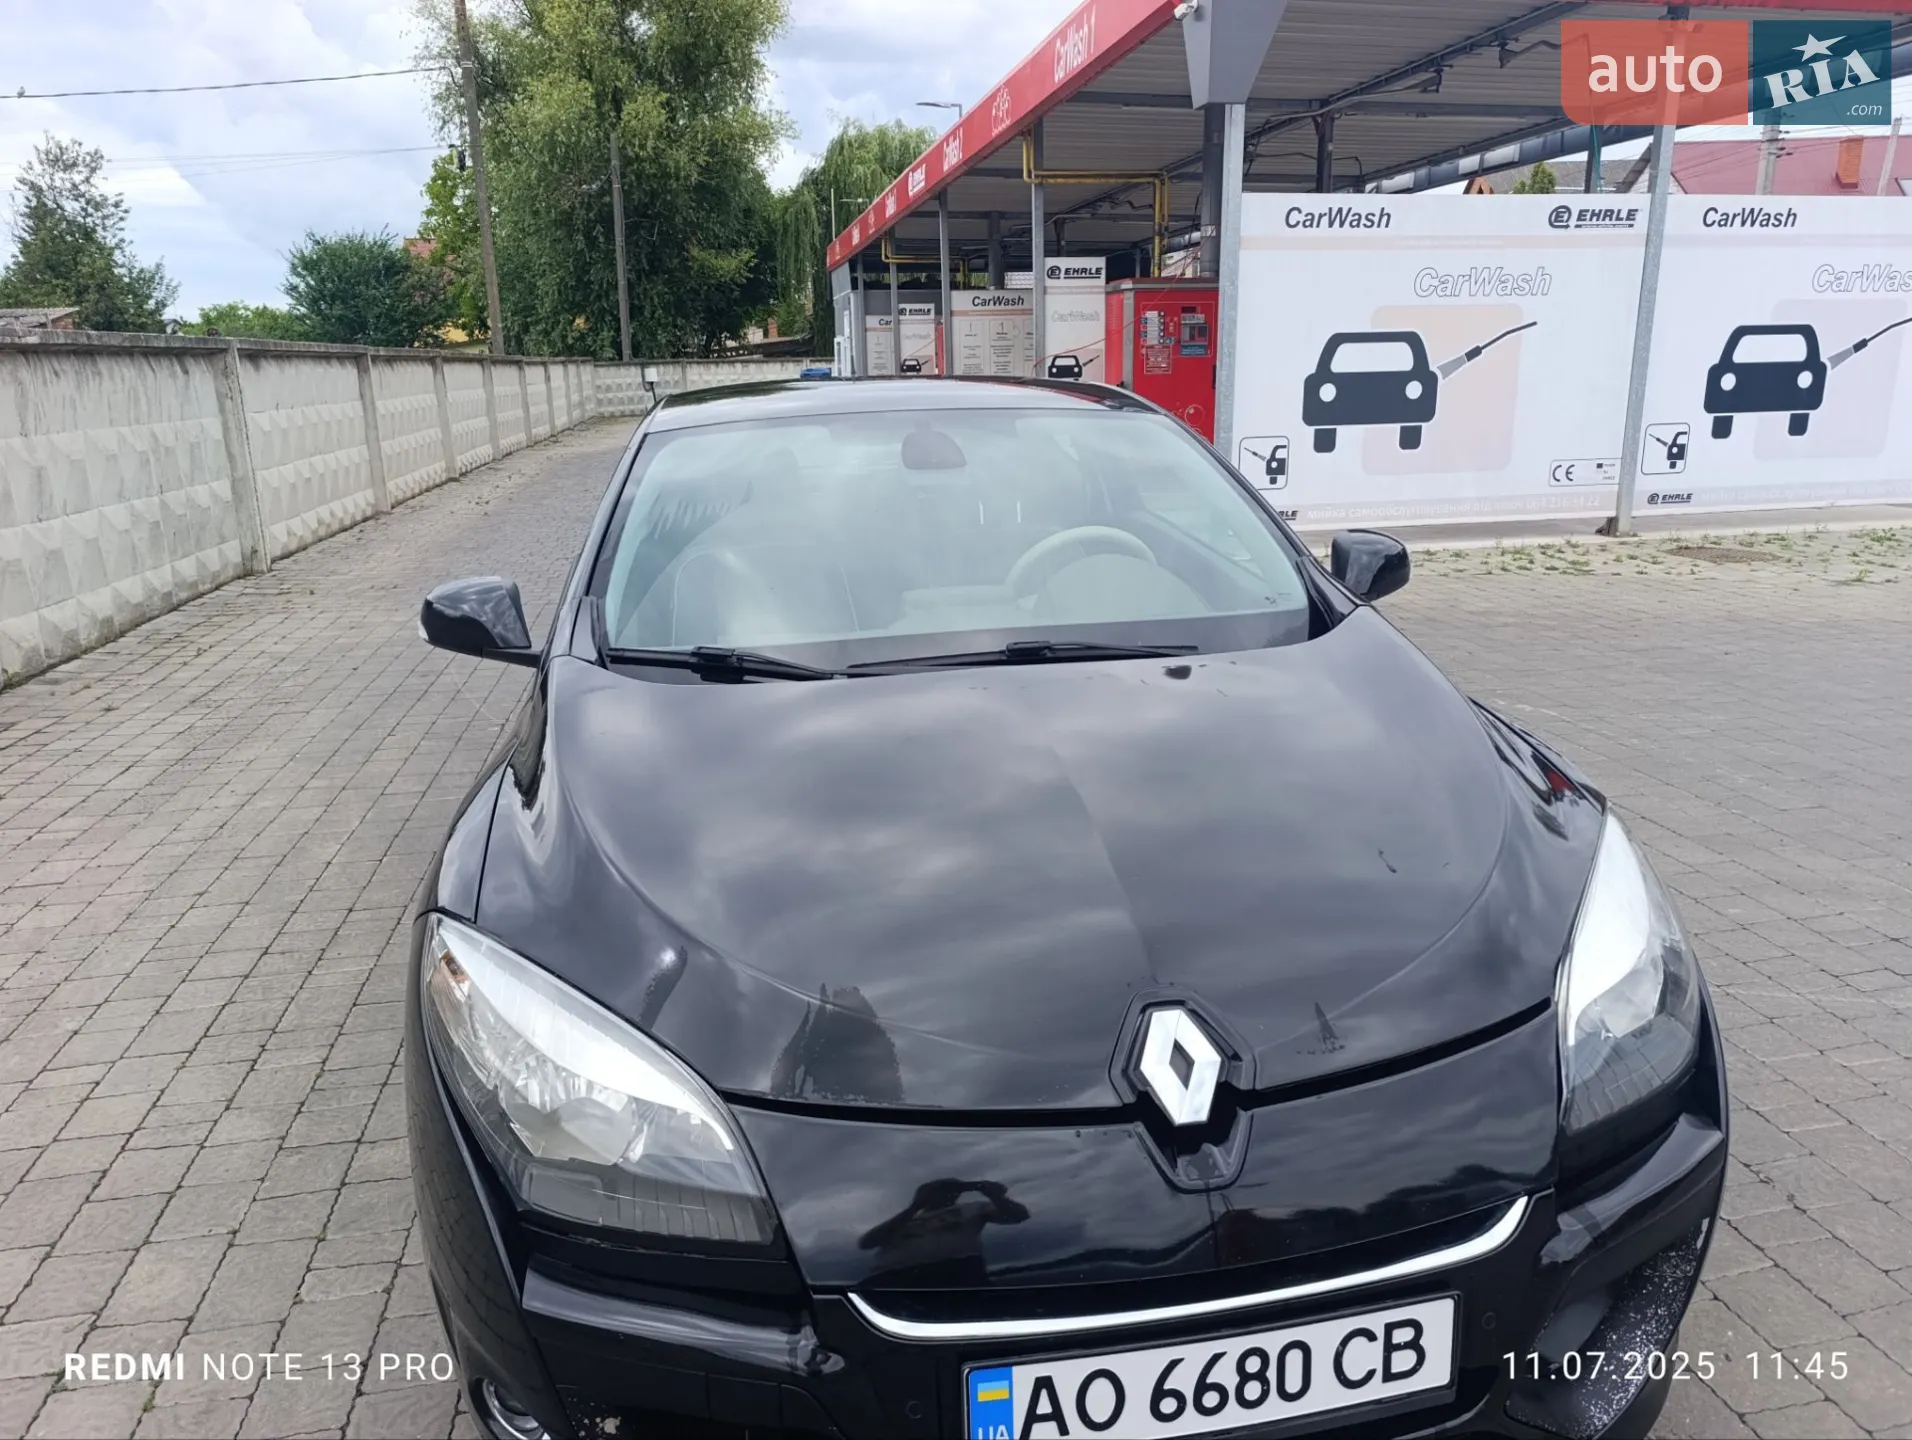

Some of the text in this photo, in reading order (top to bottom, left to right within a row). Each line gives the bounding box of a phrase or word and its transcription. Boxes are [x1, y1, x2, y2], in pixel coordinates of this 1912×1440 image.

[1054, 13, 1090, 84] CarWash
[1284, 206, 1392, 230] CarWash
[1575, 208, 1639, 222] EHRLE
[1702, 206, 1798, 229] CarWash
[1063, 267, 1103, 276] EHRLE
[1413, 266, 1552, 298] CarWash
[971, 295, 1024, 308] CarWash
[1661, 493, 1694, 502] EHRLE
[1018, 1317, 1427, 1440] AO 6680 CB
